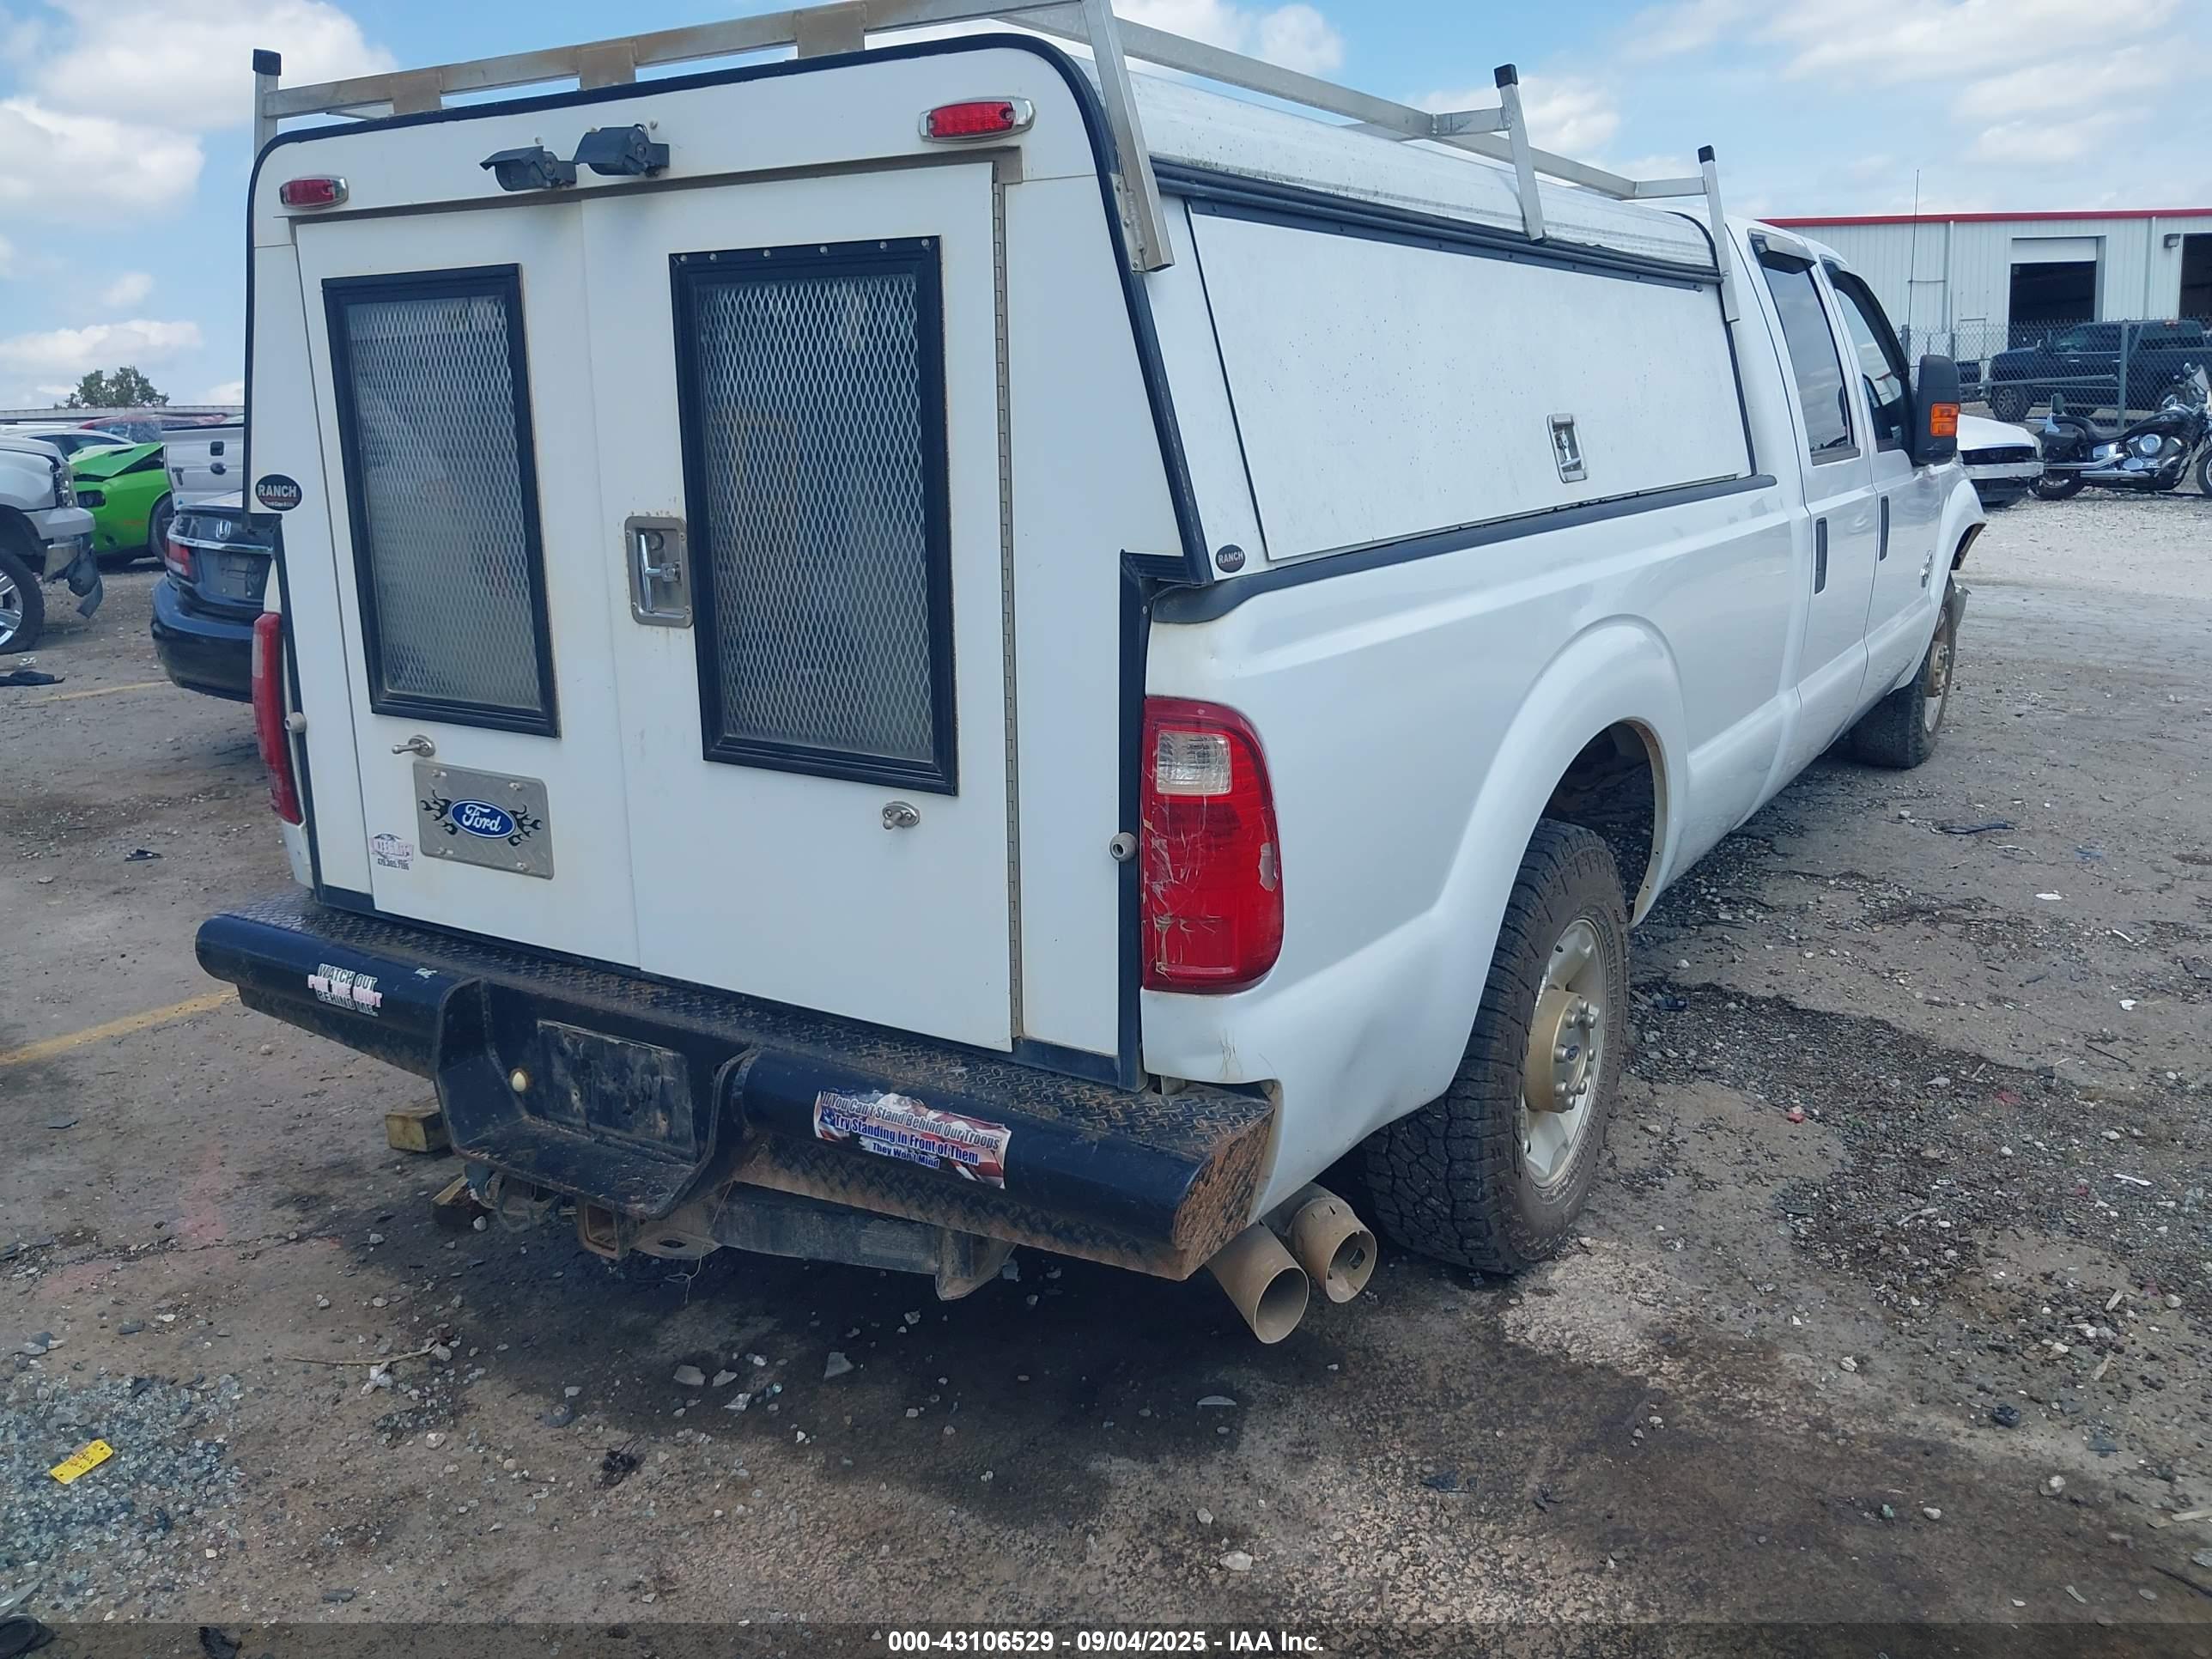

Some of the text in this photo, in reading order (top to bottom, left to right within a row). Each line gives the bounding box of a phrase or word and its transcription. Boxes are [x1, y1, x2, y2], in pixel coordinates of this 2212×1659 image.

[258, 484, 297, 497] RANCH
[1218, 550, 1243, 564] RANCH
[462, 804, 502, 832] Ford
[318, 963, 356, 986] WATCH
[356, 974, 378, 991] OUT
[822, 1091, 1000, 1150] If You Can't Stand Behind Our Troops
[835, 1113, 979, 1164] Try Standing In Front of Them
[872, 1142, 893, 1156] They
[918, 1155, 939, 1168] Mind
